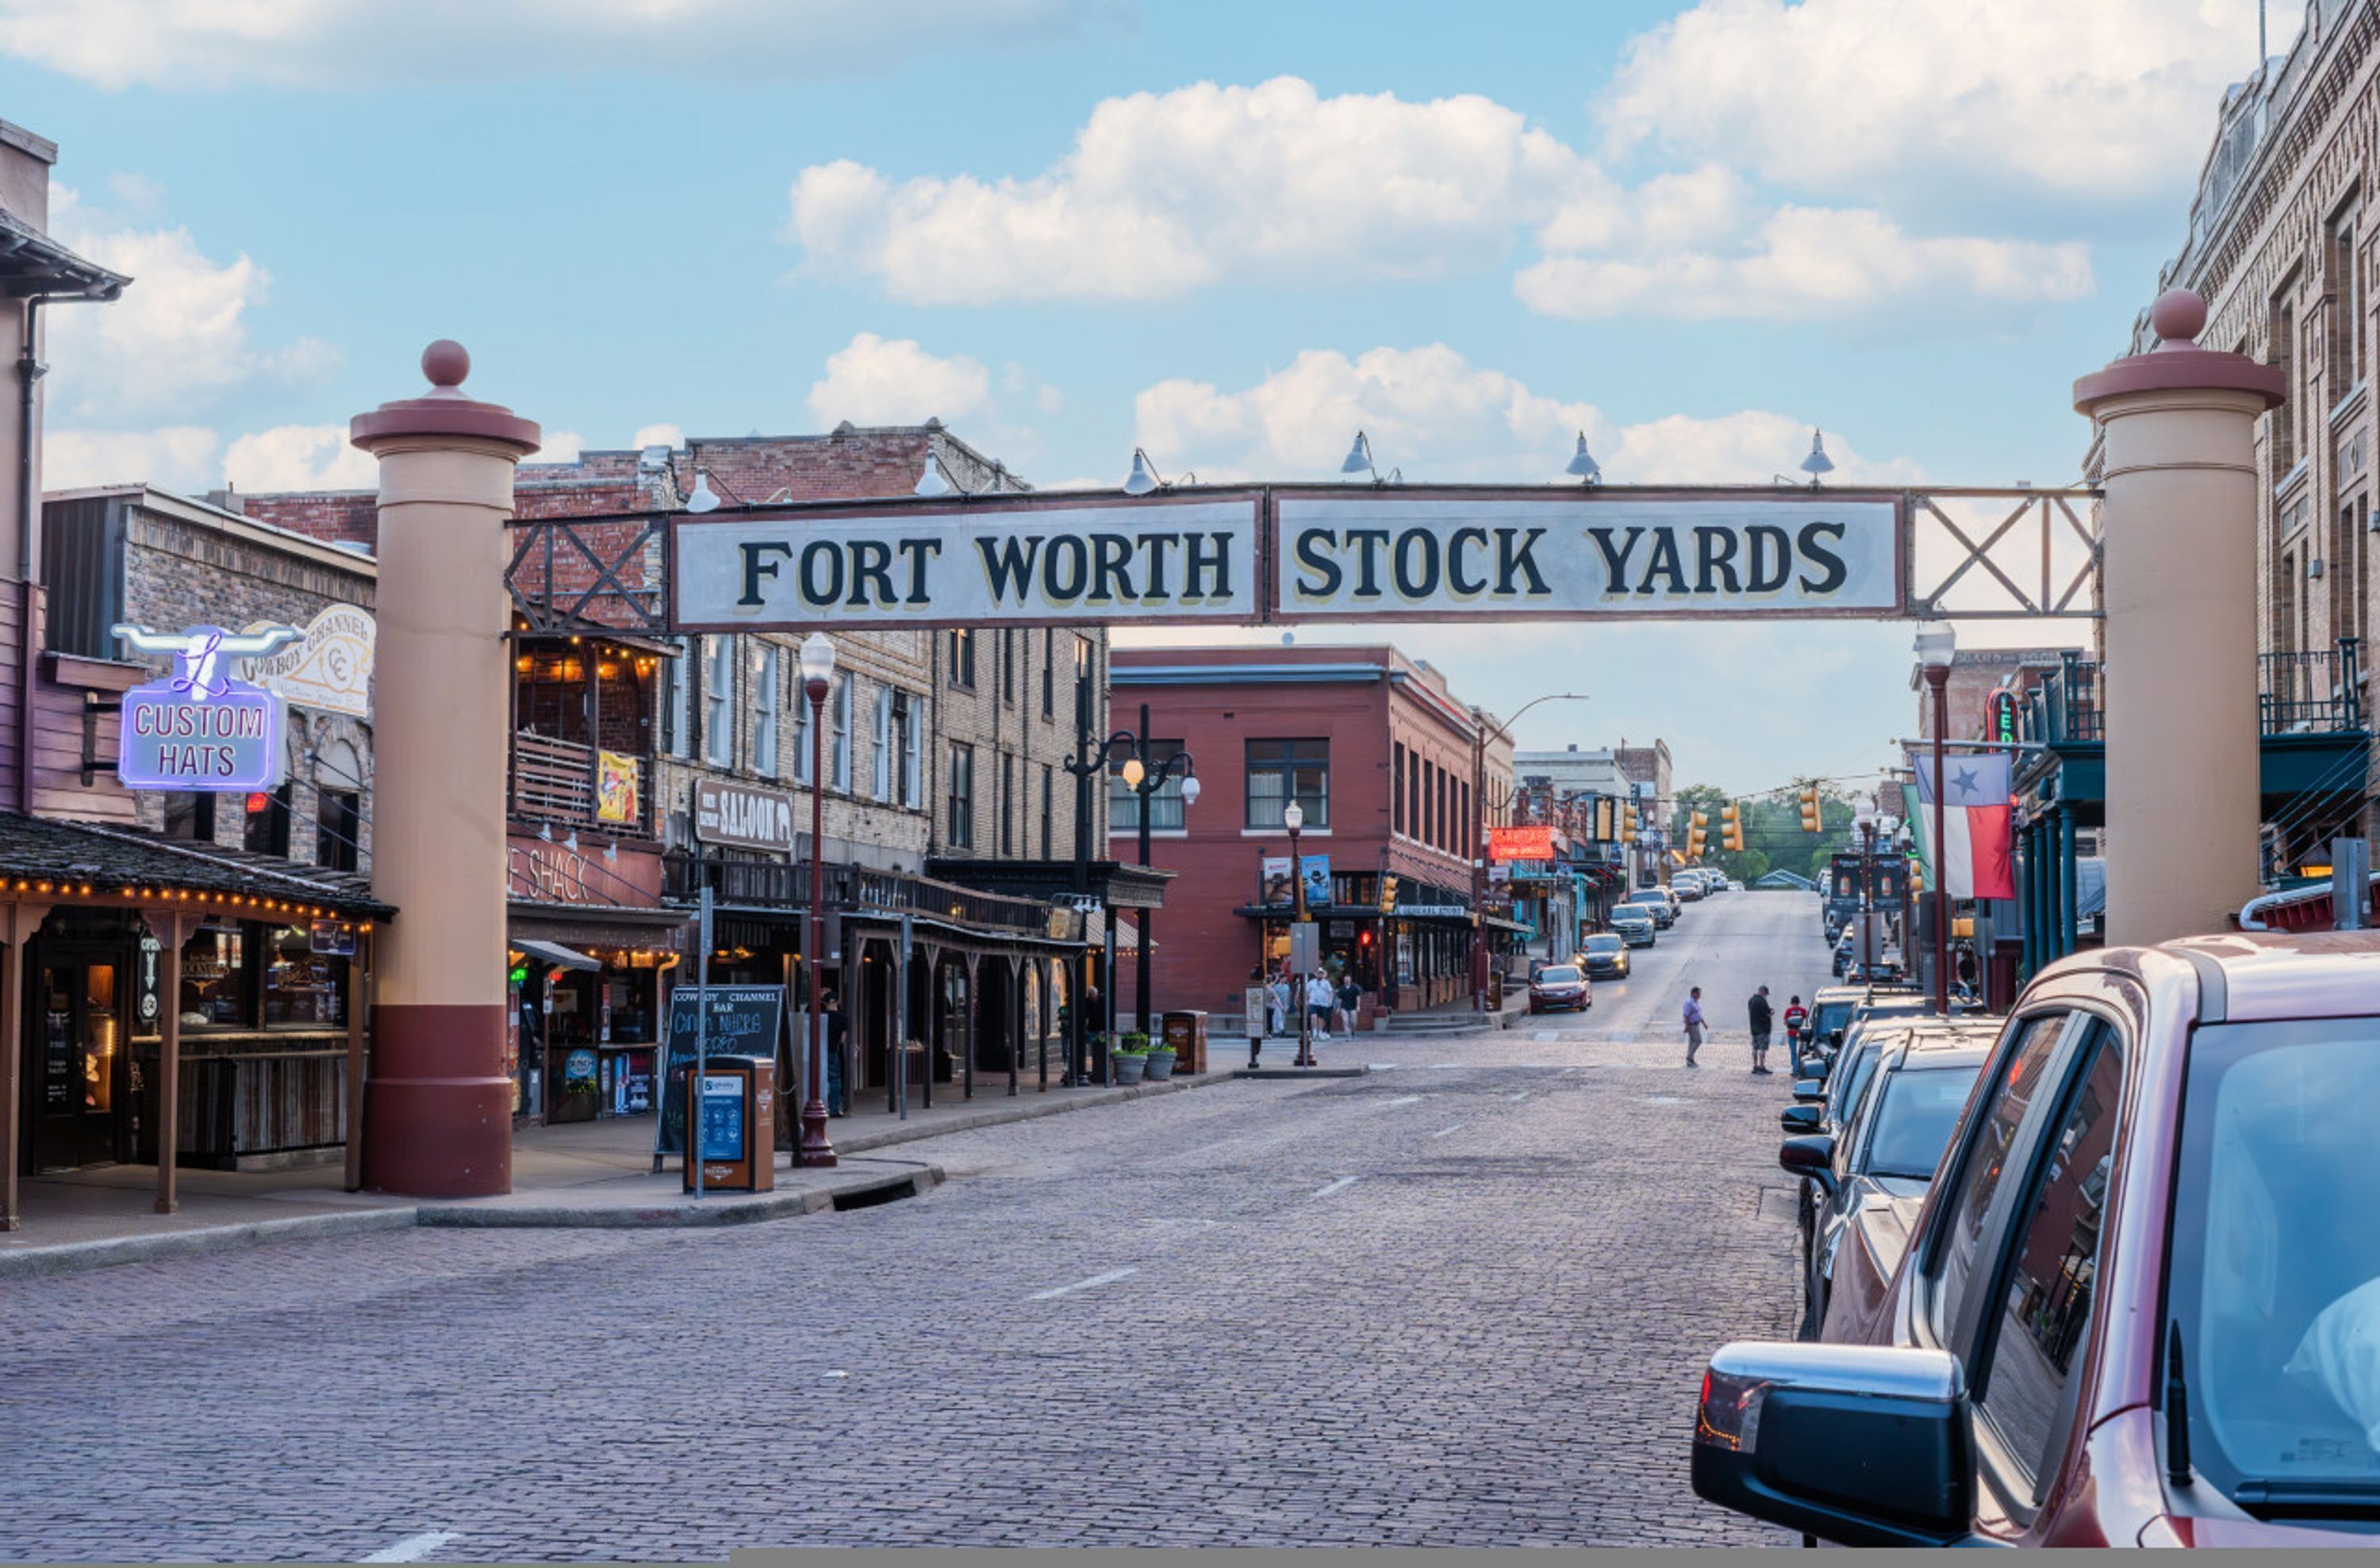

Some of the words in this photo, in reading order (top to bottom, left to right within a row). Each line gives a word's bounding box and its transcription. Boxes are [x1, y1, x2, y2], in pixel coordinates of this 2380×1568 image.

[734, 538, 942, 612] FORT
[973, 532, 1234, 608] WORTH
[1293, 527, 1551, 602] STOCK
[1586, 521, 1847, 600] YARDS
[306, 614, 367, 651] CHANNEL
[134, 704, 264, 739] CUSTOM
[159, 744, 236, 777] HATS
[720, 790, 775, 841] SALOON
[528, 849, 589, 900] SHACK
[675, 993, 719, 1001] COWOY
[729, 993, 777, 1001] CHANNEL
[712, 1003, 734, 1013] BAR
